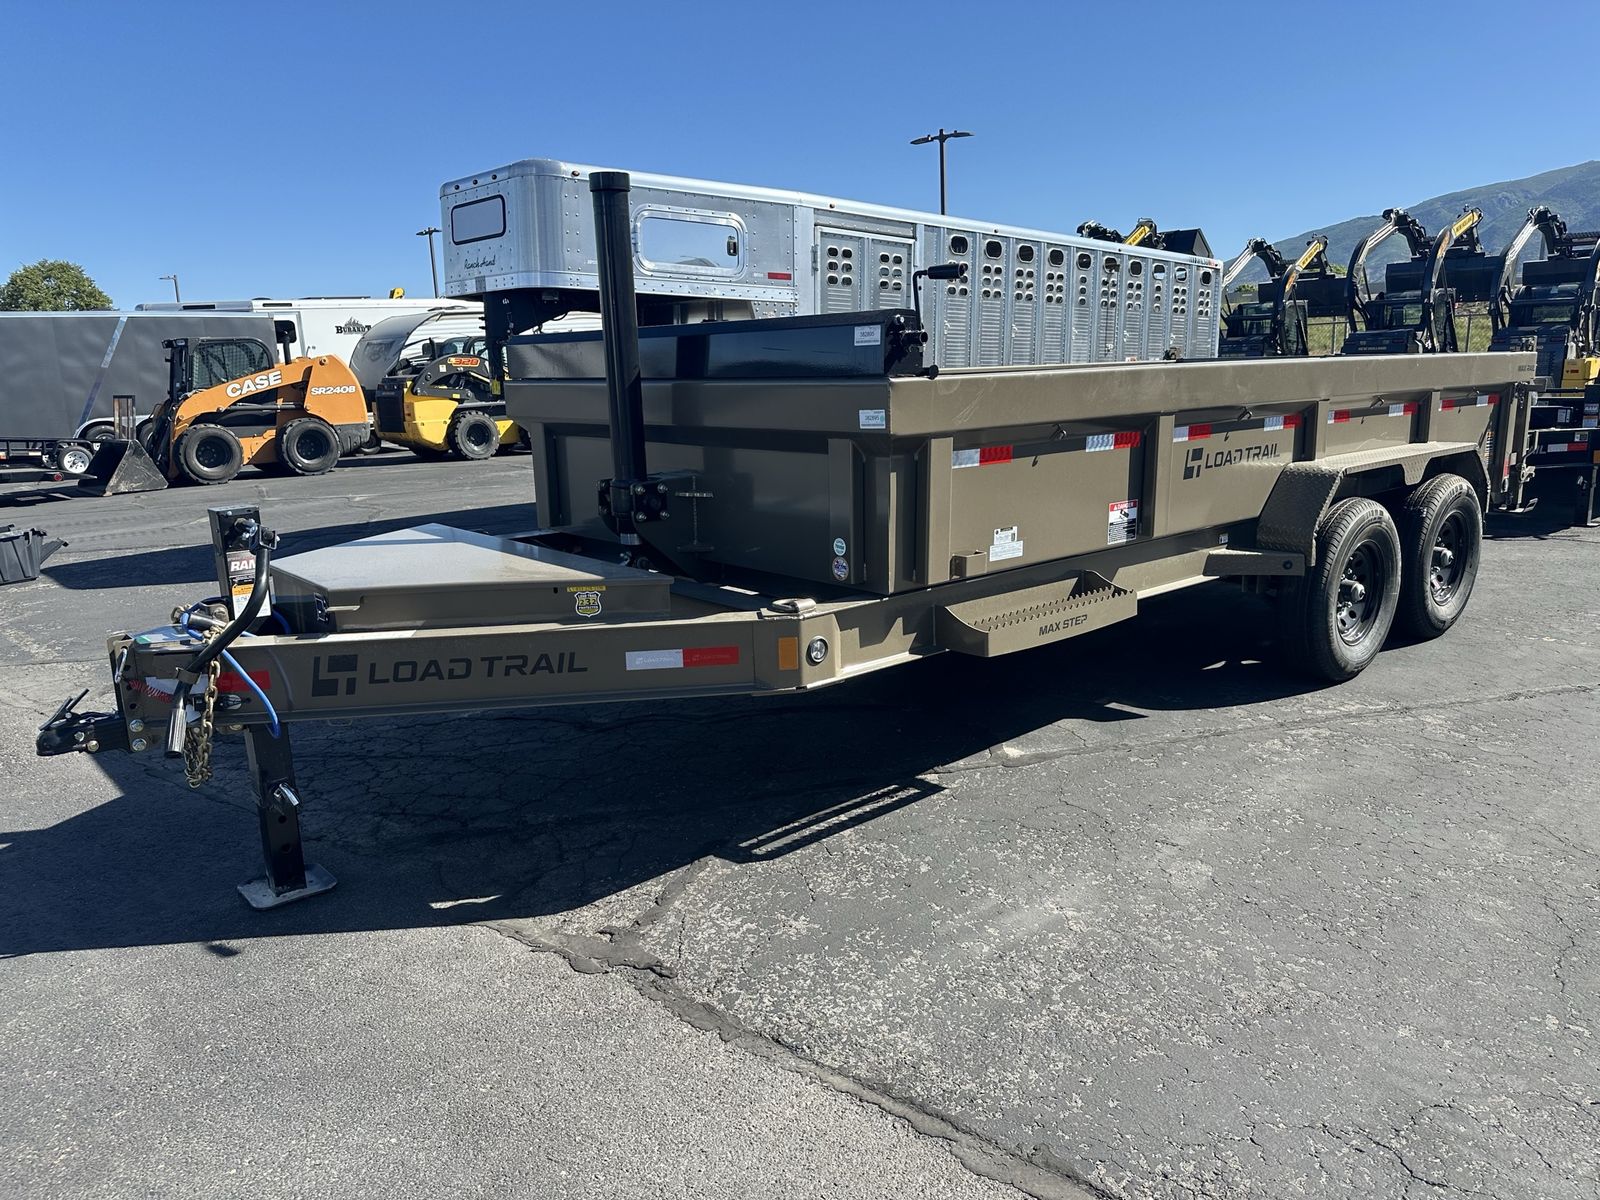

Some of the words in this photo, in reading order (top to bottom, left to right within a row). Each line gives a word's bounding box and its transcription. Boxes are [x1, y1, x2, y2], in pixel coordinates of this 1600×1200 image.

[226, 370, 282, 398] CASE
[310, 385, 356, 396] SR240B
[1205, 448, 1243, 469] LOAD
[1245, 443, 1280, 463] TRAIL
[1039, 621, 1062, 636] MAX
[1062, 614, 1088, 630] STEP
[368, 658, 472, 685] LOAD
[480, 652, 588, 678] TRAIL
